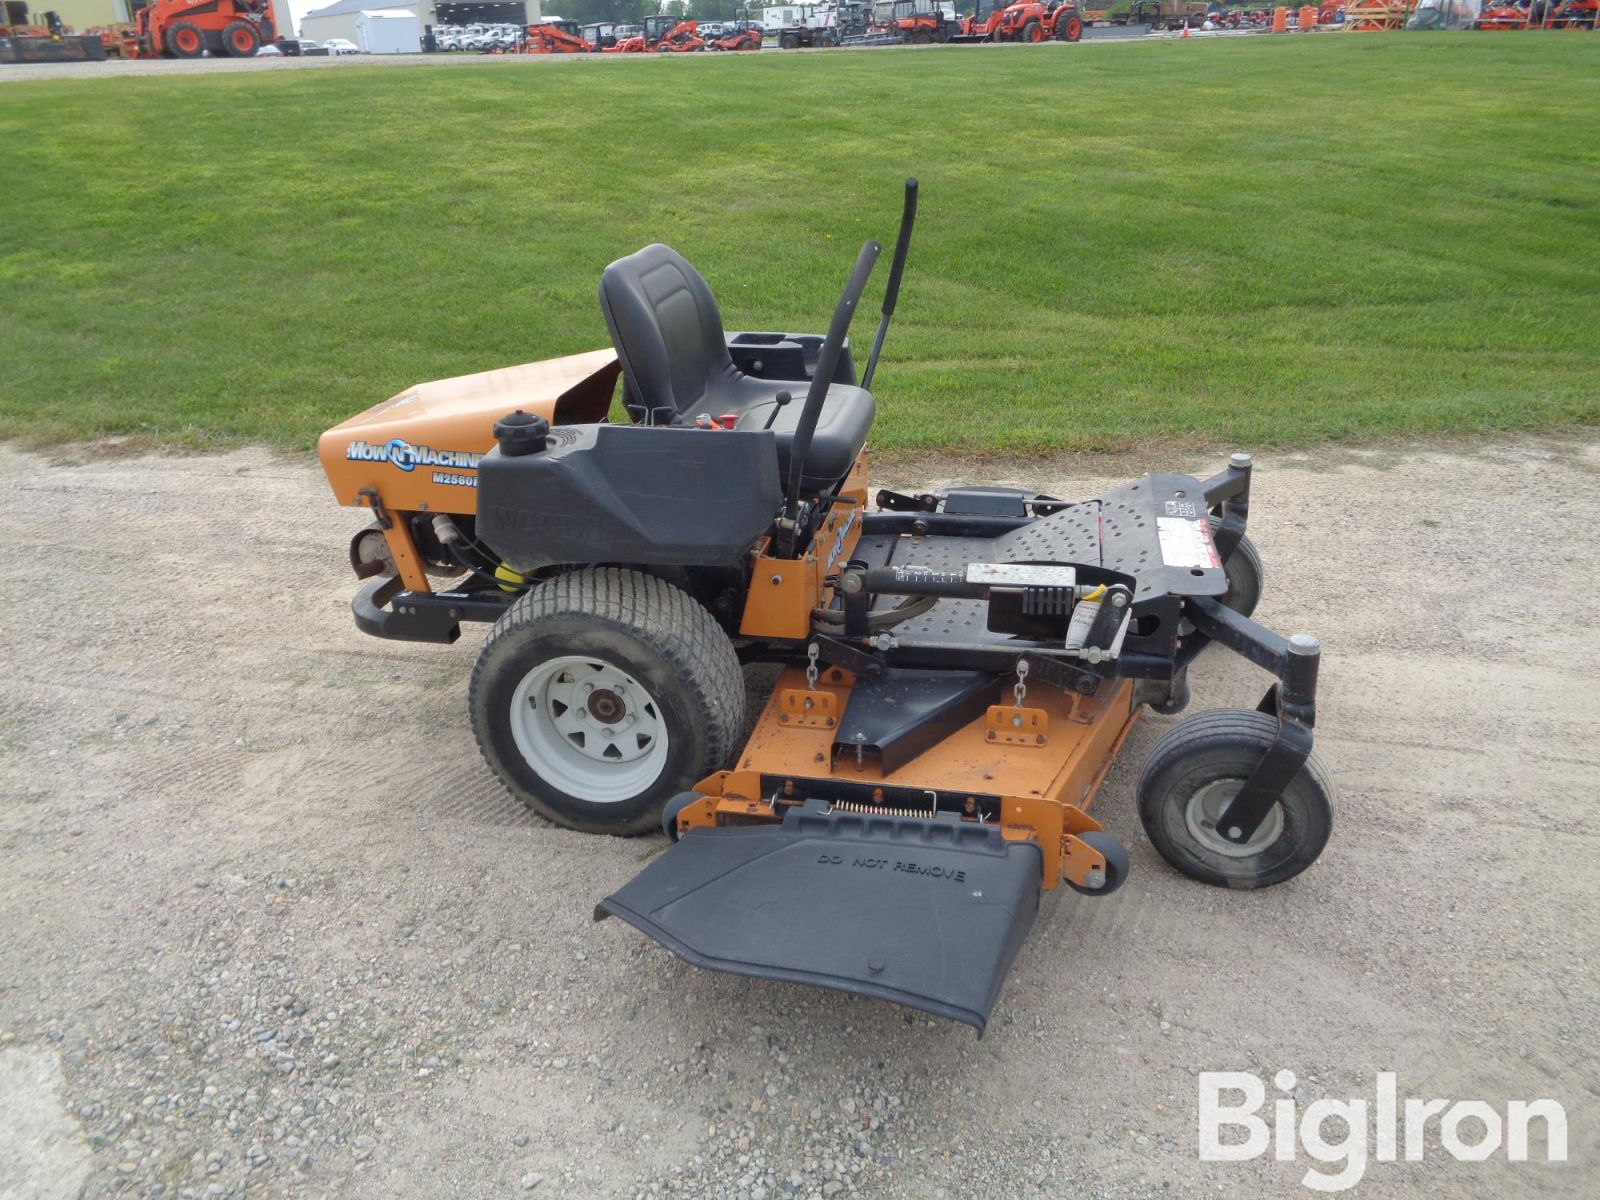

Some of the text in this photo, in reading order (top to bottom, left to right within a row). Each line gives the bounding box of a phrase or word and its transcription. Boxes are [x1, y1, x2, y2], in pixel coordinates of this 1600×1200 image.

[346, 441, 387, 461] MOW
[817, 855, 966, 883] DO NOT REMOVE
